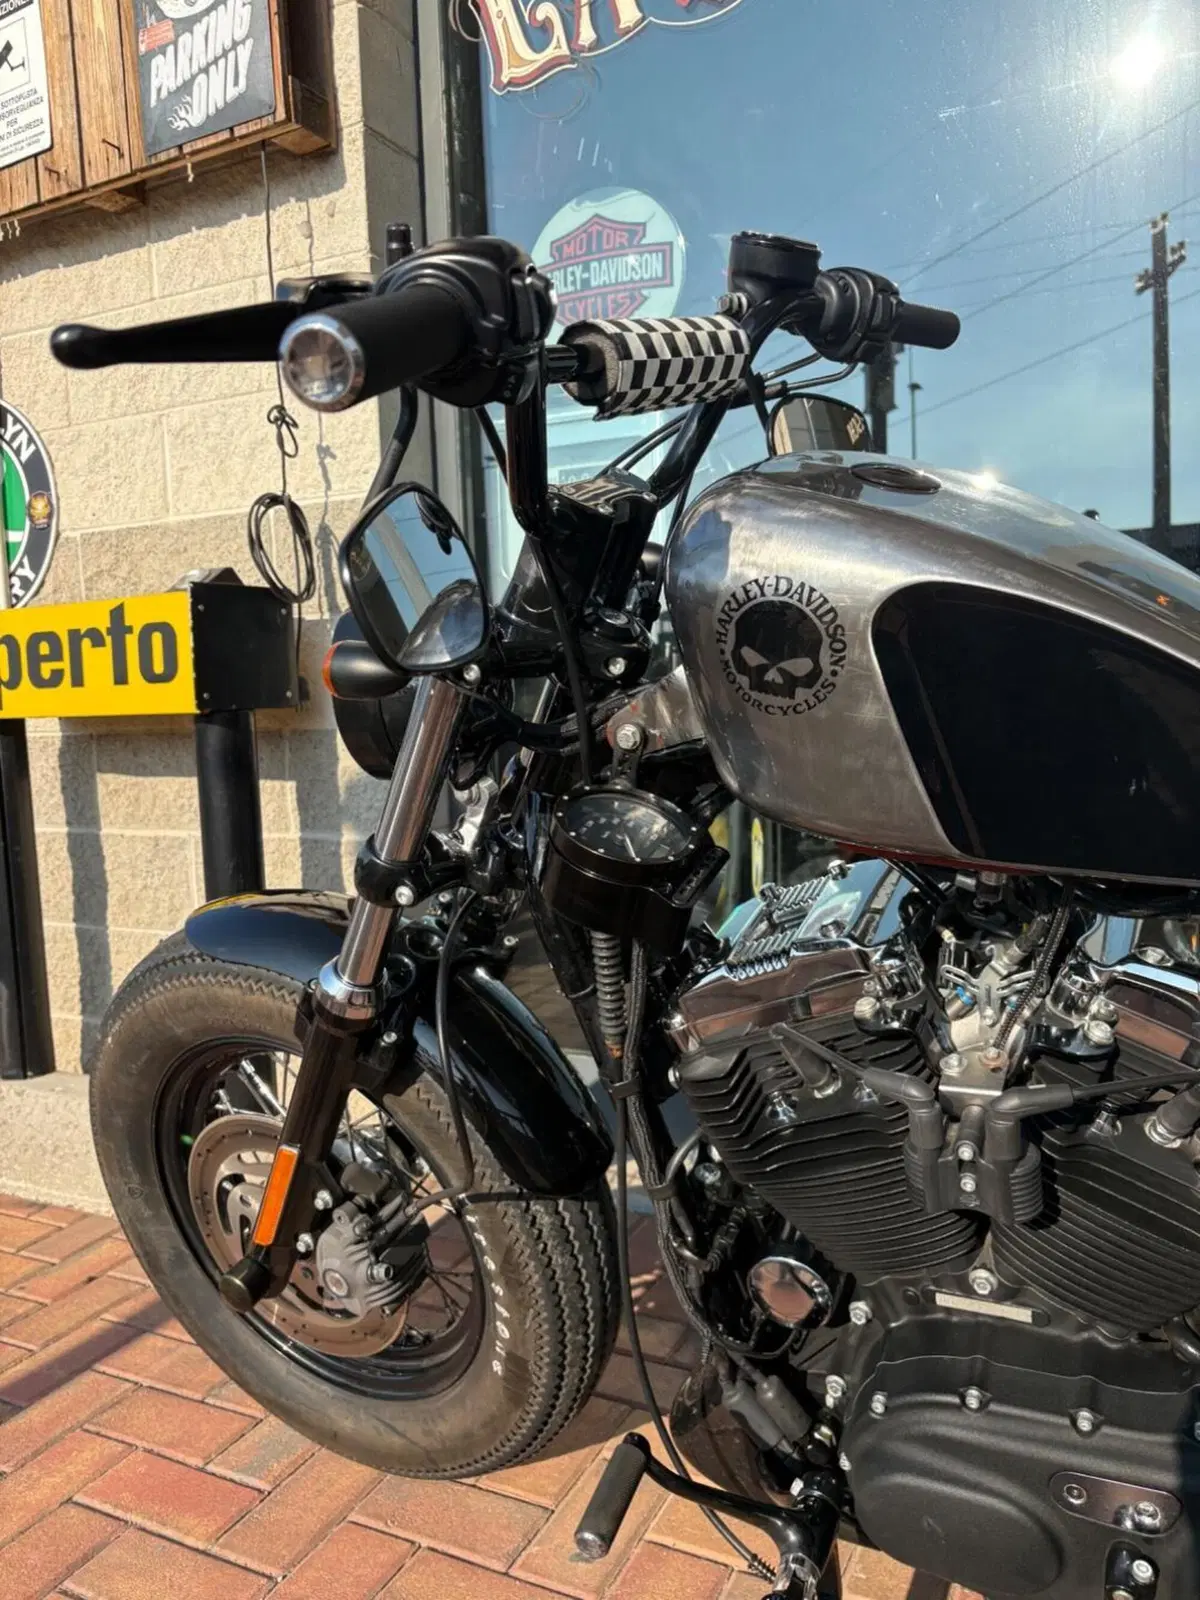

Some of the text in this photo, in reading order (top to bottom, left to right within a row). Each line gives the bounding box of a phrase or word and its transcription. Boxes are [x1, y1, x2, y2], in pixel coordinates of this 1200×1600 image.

[150, 0, 251, 108] PARKING
[190, 37, 254, 128] ONLY
[562, 225, 630, 260] MOTOR
[0, 412, 36, 464] YN
[716, 575, 848, 670] HARLEY-DAVIDSON
[720, 658, 837, 716] MOTORCYCLES
[458, 1194, 511, 1376] irestone
